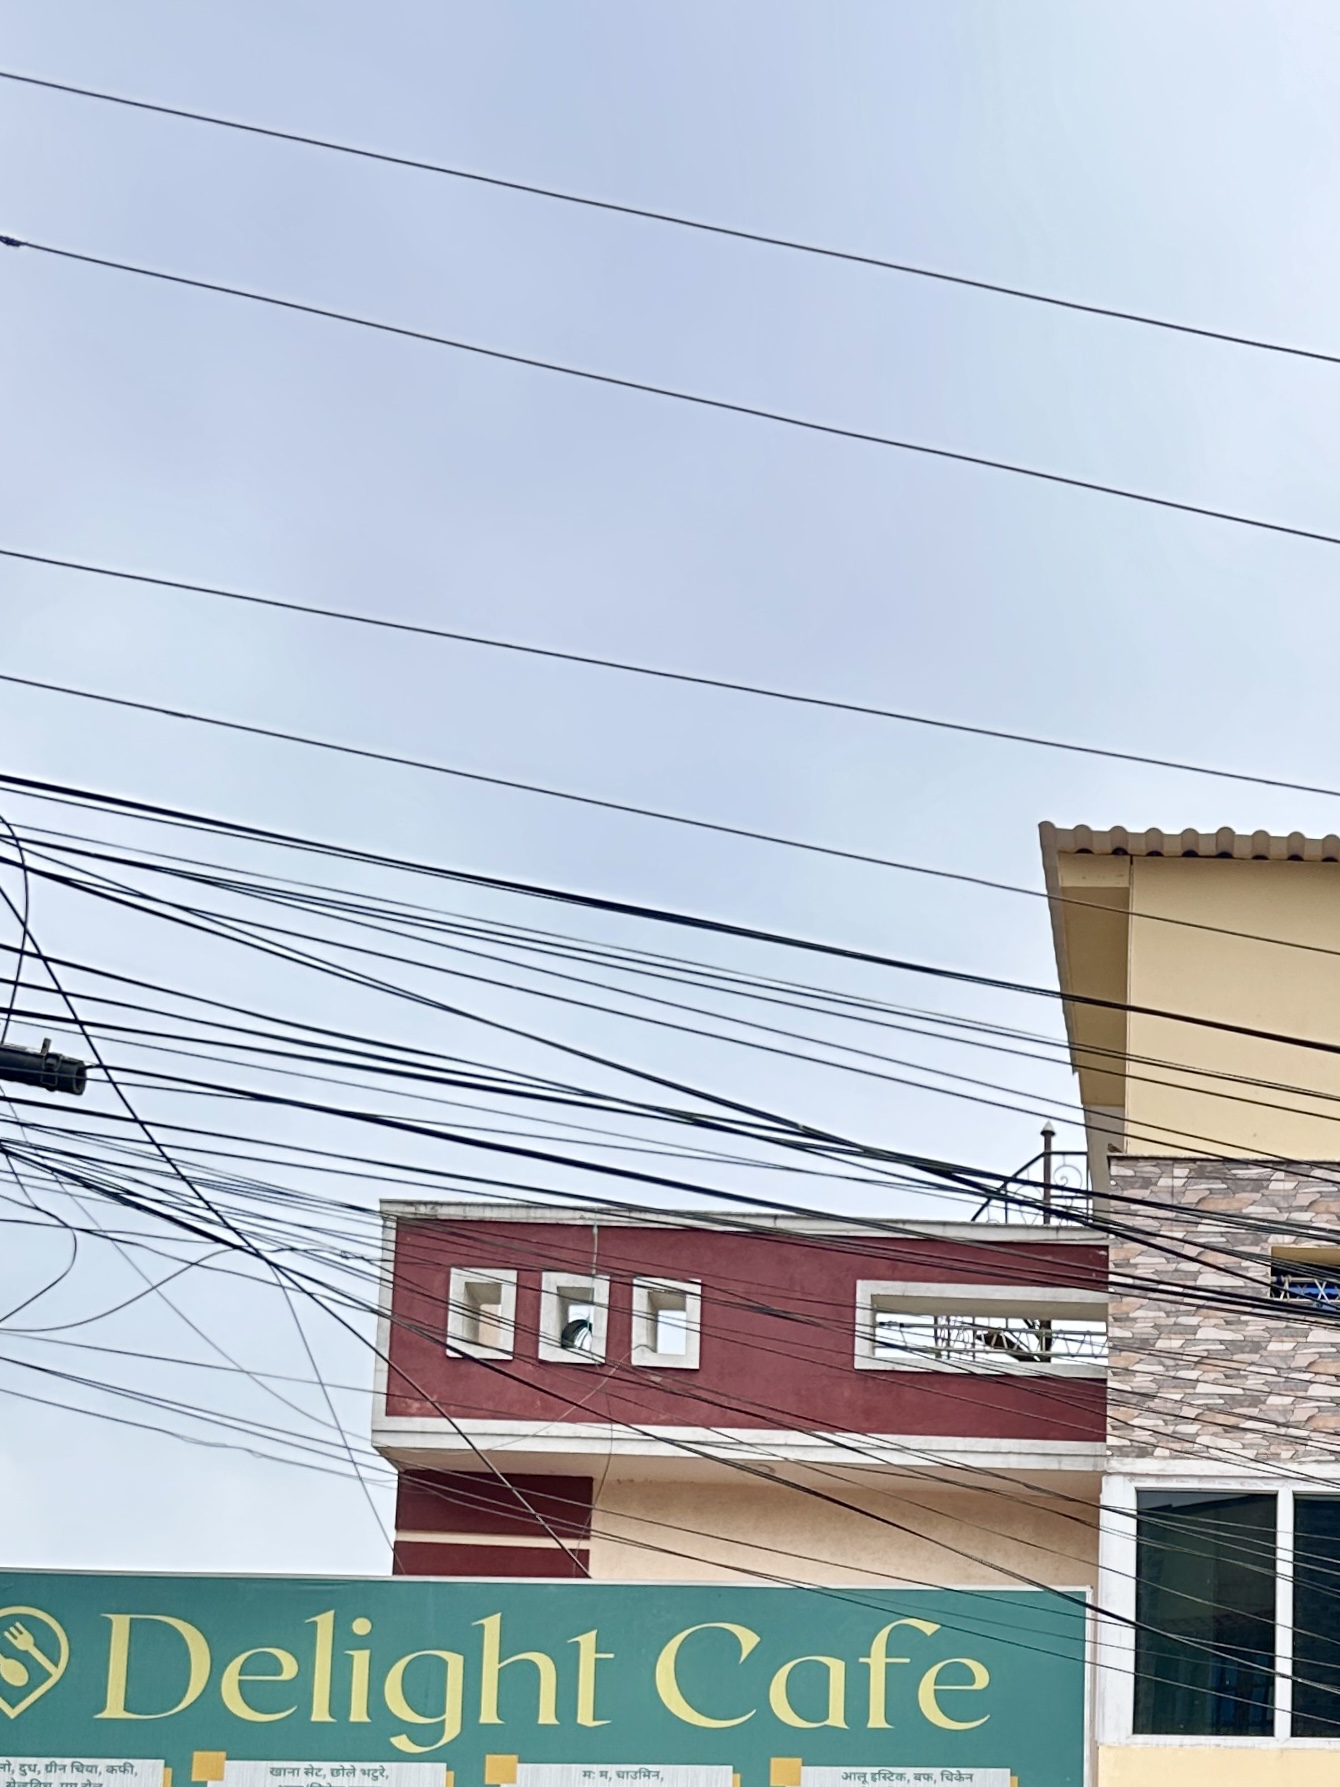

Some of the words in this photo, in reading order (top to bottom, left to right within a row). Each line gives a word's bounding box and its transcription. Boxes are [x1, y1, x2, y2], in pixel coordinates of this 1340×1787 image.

[93, 1609, 615, 1753] Delight
[655, 1618, 991, 1730] Cafe
[269, 1766, 300, 1777] खाना
